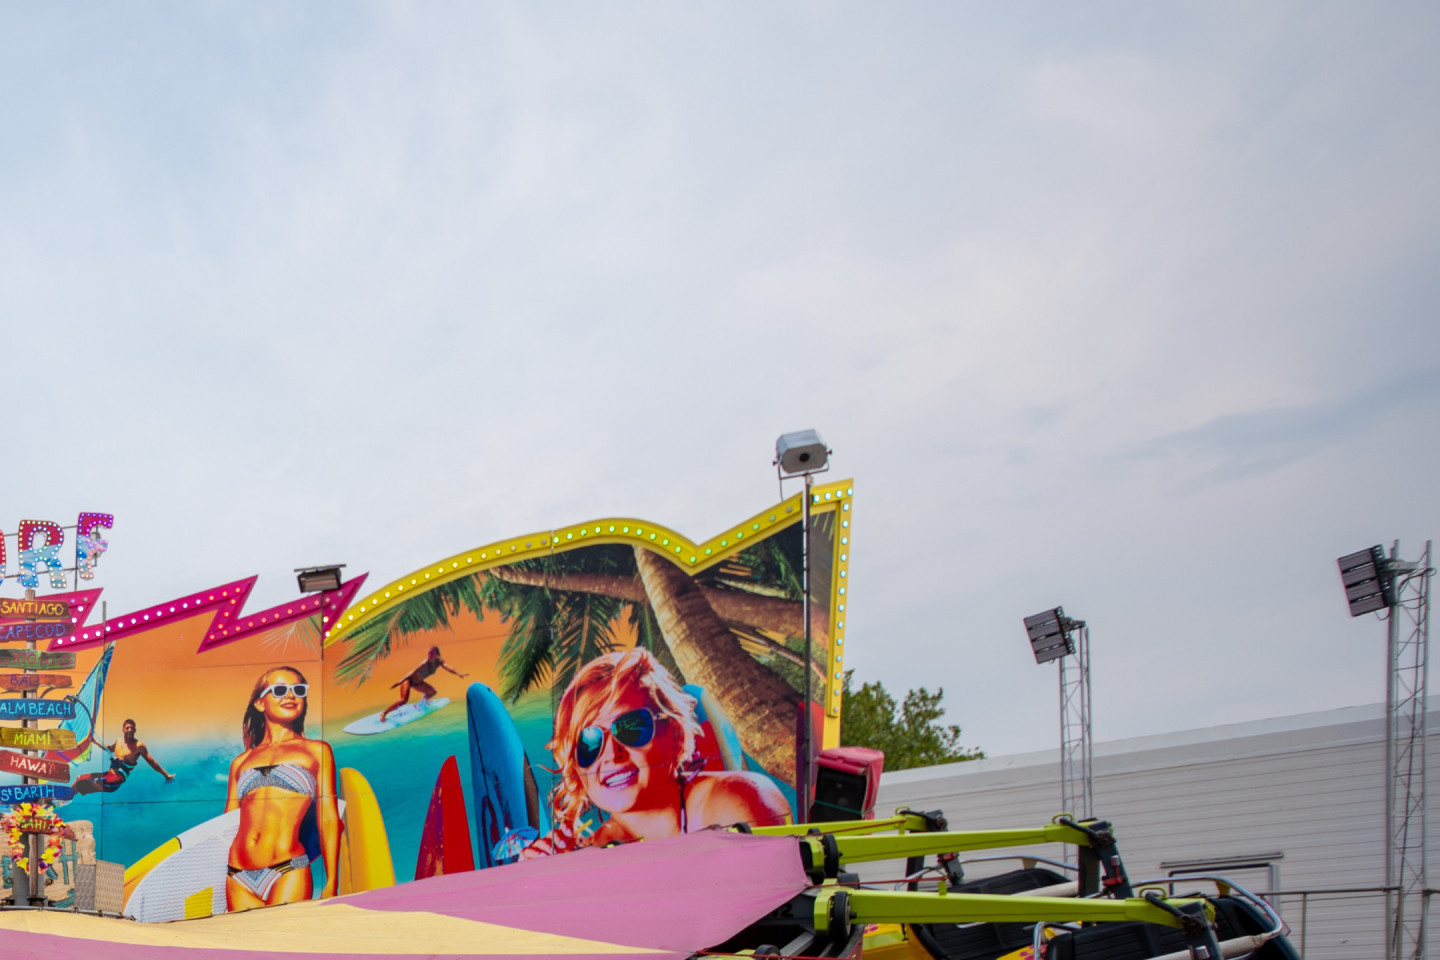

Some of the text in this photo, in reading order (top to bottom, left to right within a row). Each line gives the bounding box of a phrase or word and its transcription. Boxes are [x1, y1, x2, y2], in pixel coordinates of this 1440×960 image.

[0, 601, 64, 616] SANTIAGO
[40, 654, 71, 667] RICO
[10, 674, 39, 687] BALI
[28, 702, 71, 716] BEACH
[14, 786, 55, 800] BARTH
